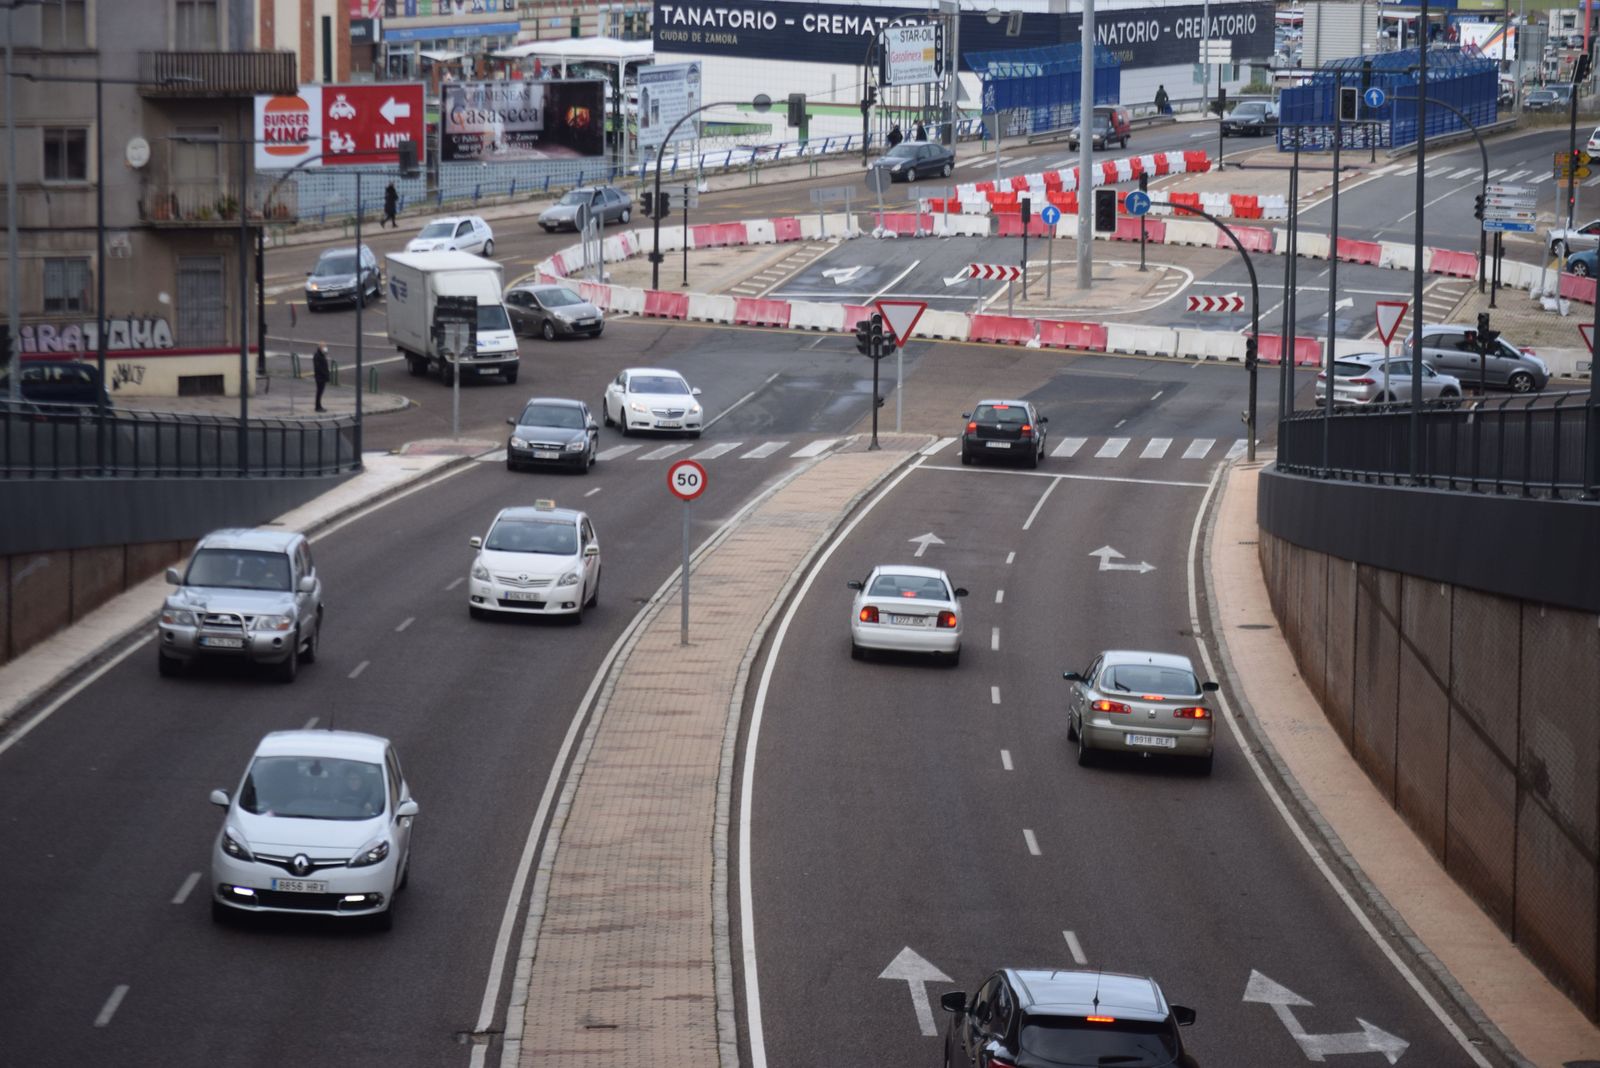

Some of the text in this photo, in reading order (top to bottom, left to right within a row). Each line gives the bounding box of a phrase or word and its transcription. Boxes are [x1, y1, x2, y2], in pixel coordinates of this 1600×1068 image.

[660, 6, 777, 30] TANATORIO
[659, 31, 738, 45] CIUDAD DE ZAMORA
[900, 29, 934, 43] STAR-OIL
[264, 114, 309, 126] BURGER
[450, 104, 538, 125] Casaseca
[264, 127, 309, 144] KING
[677, 473, 698, 487] 50
